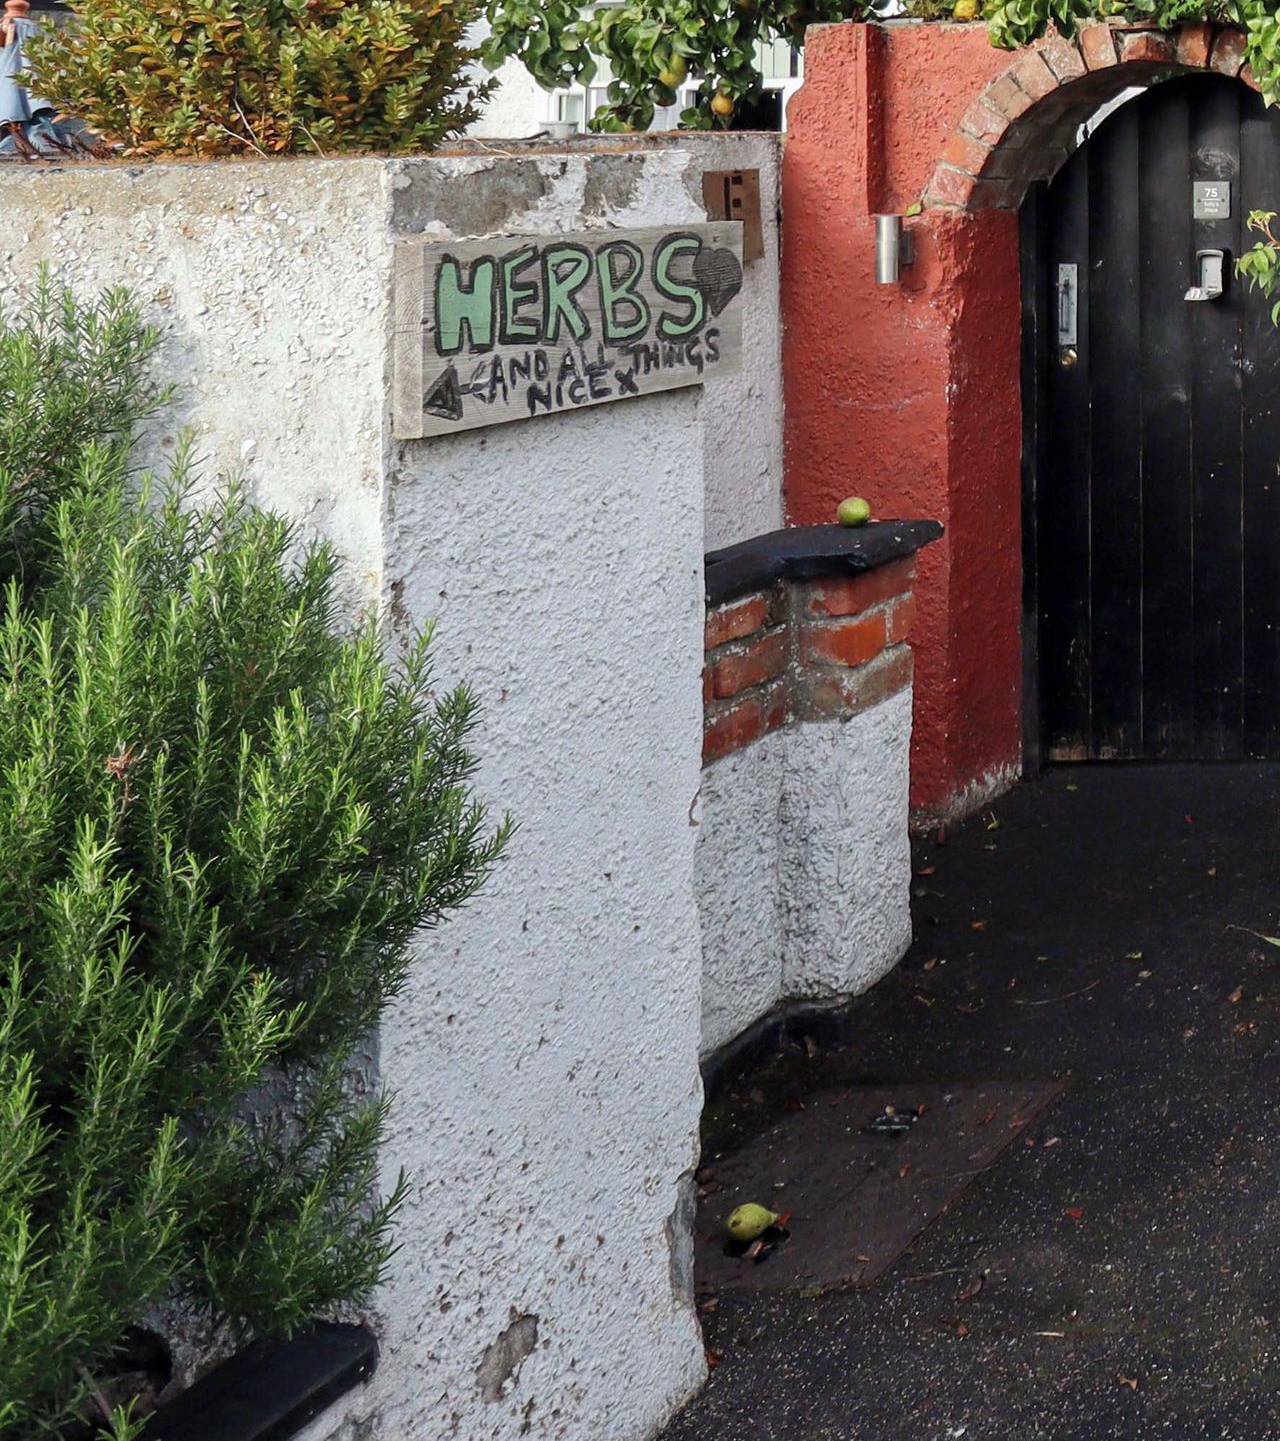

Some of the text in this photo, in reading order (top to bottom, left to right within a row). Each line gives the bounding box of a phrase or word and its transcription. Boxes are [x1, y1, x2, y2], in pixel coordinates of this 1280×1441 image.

[1204, 188, 1218, 198] 75
[434, 232, 708, 357] HERBS
[487, 327, 721, 406] AND ALL THINGS
[526, 368, 613, 416] NICE
